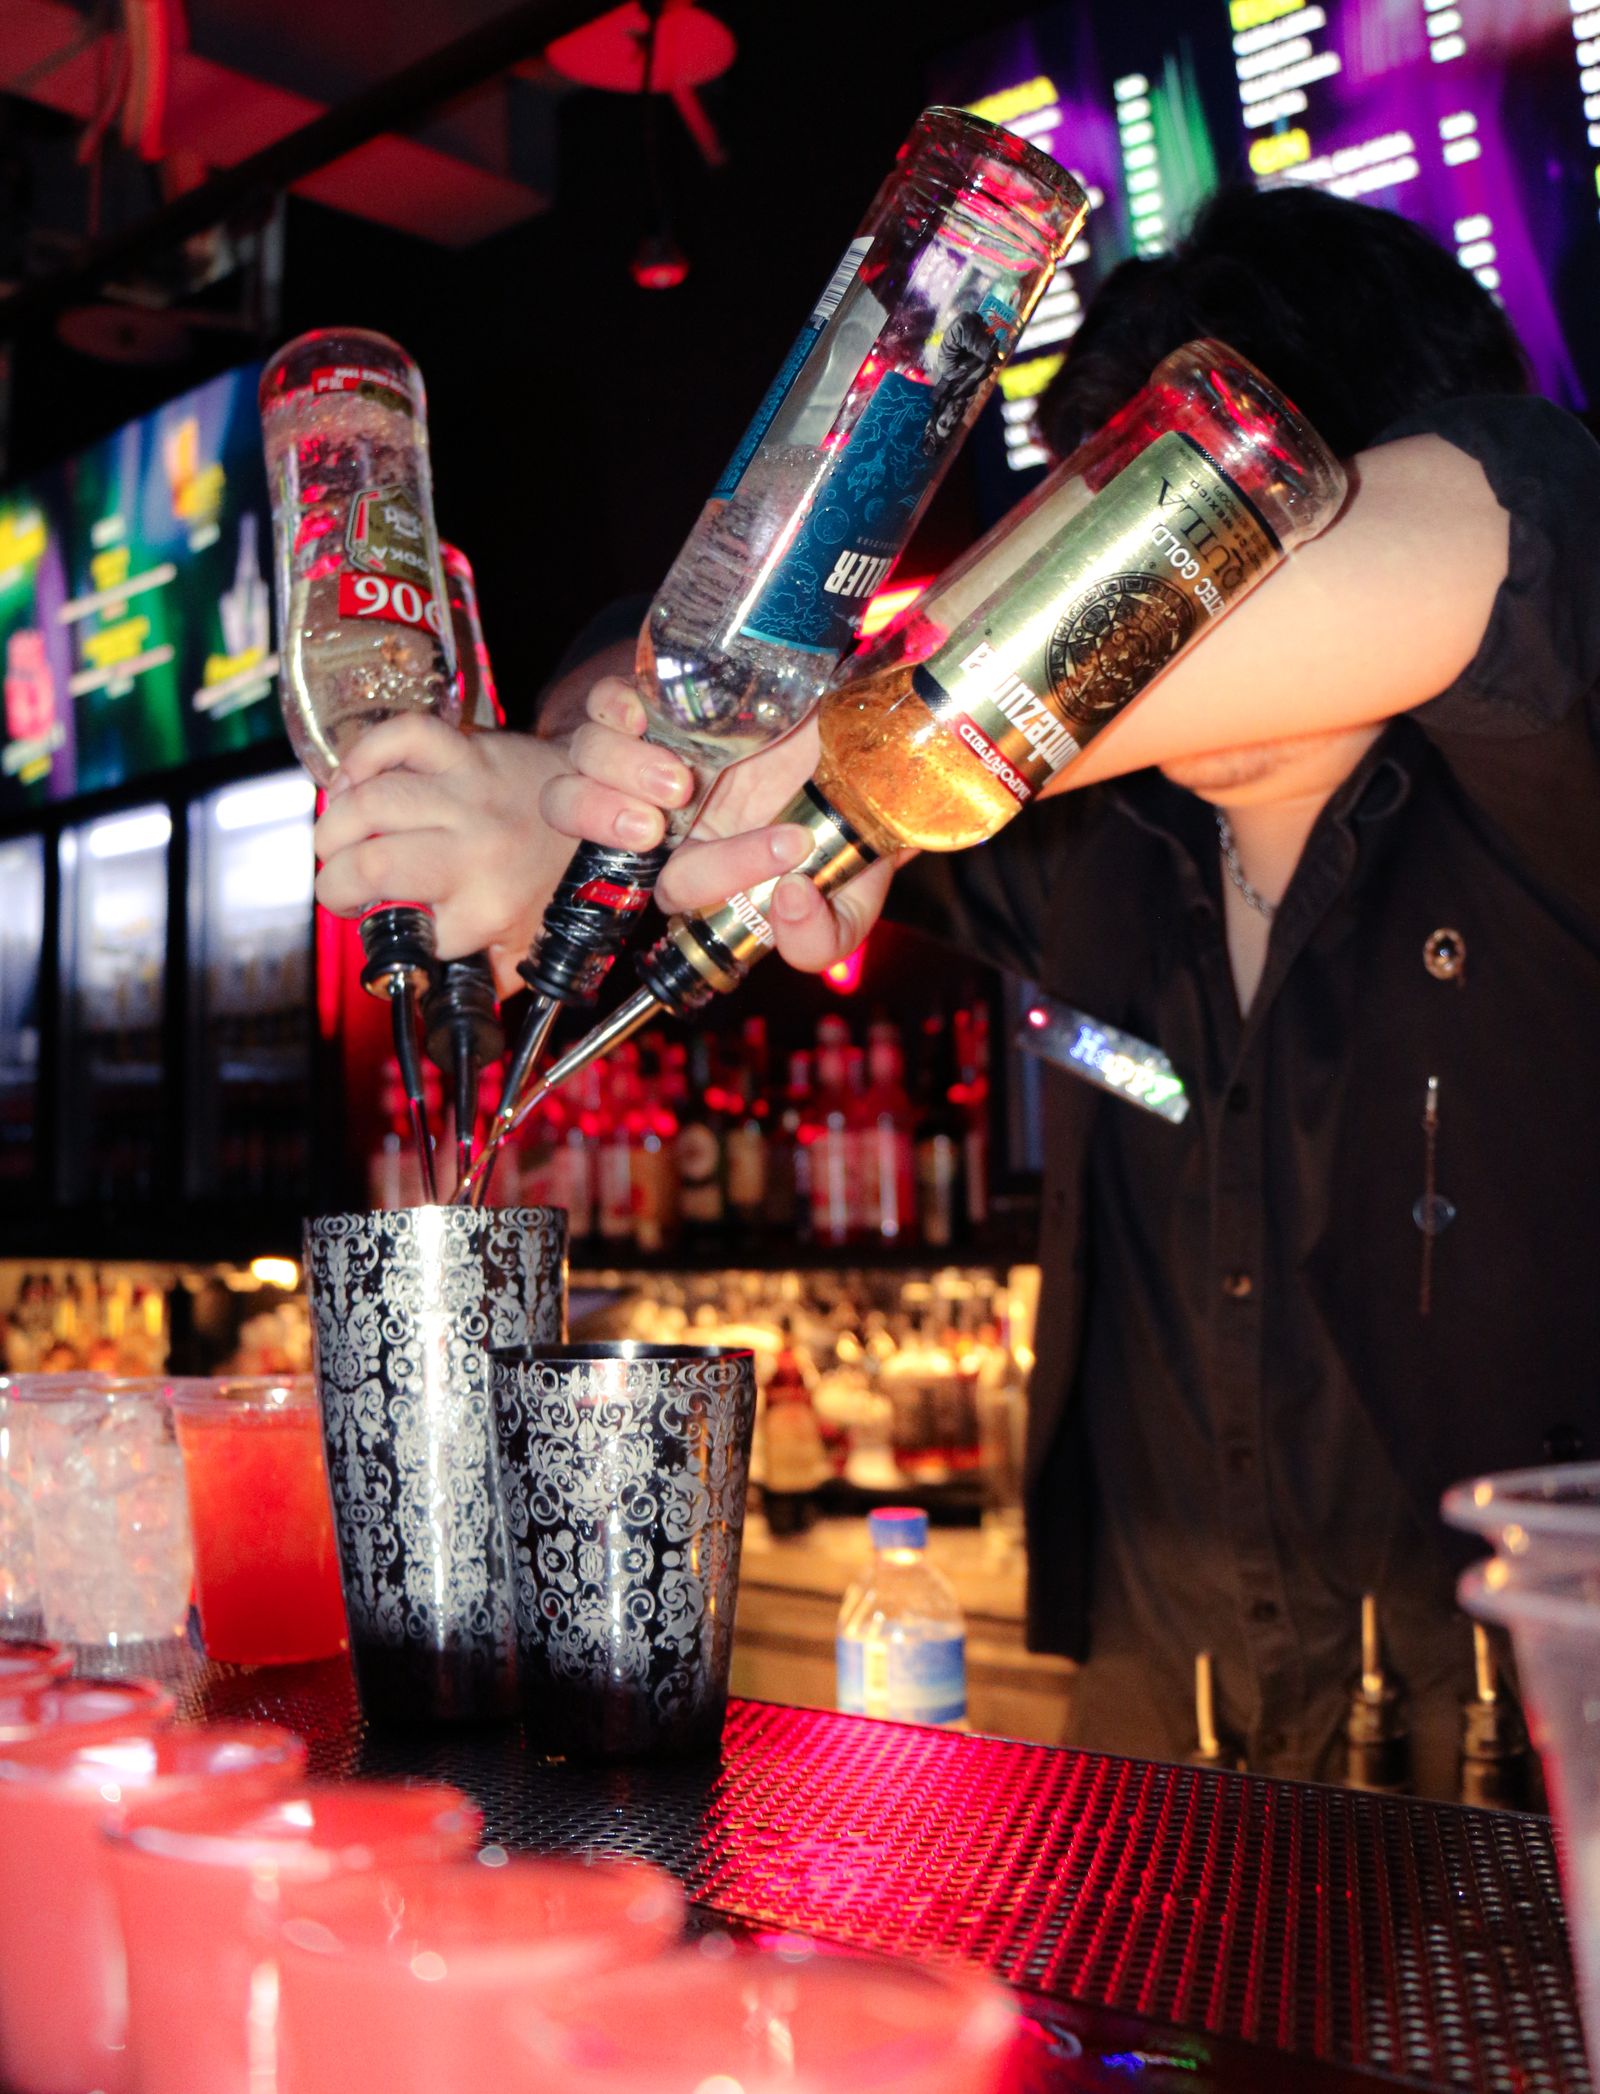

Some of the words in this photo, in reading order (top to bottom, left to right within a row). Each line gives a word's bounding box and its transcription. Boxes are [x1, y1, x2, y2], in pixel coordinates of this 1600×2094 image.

[1158, 476, 1246, 590] QUILA
[1191, 479, 1233, 530] MEXICO
[370, 544, 430, 573] ODKA
[1151, 523, 1200, 580] GOLD
[958, 640, 1082, 786] ontezua
[959, 723, 1032, 800] IMPORTED
